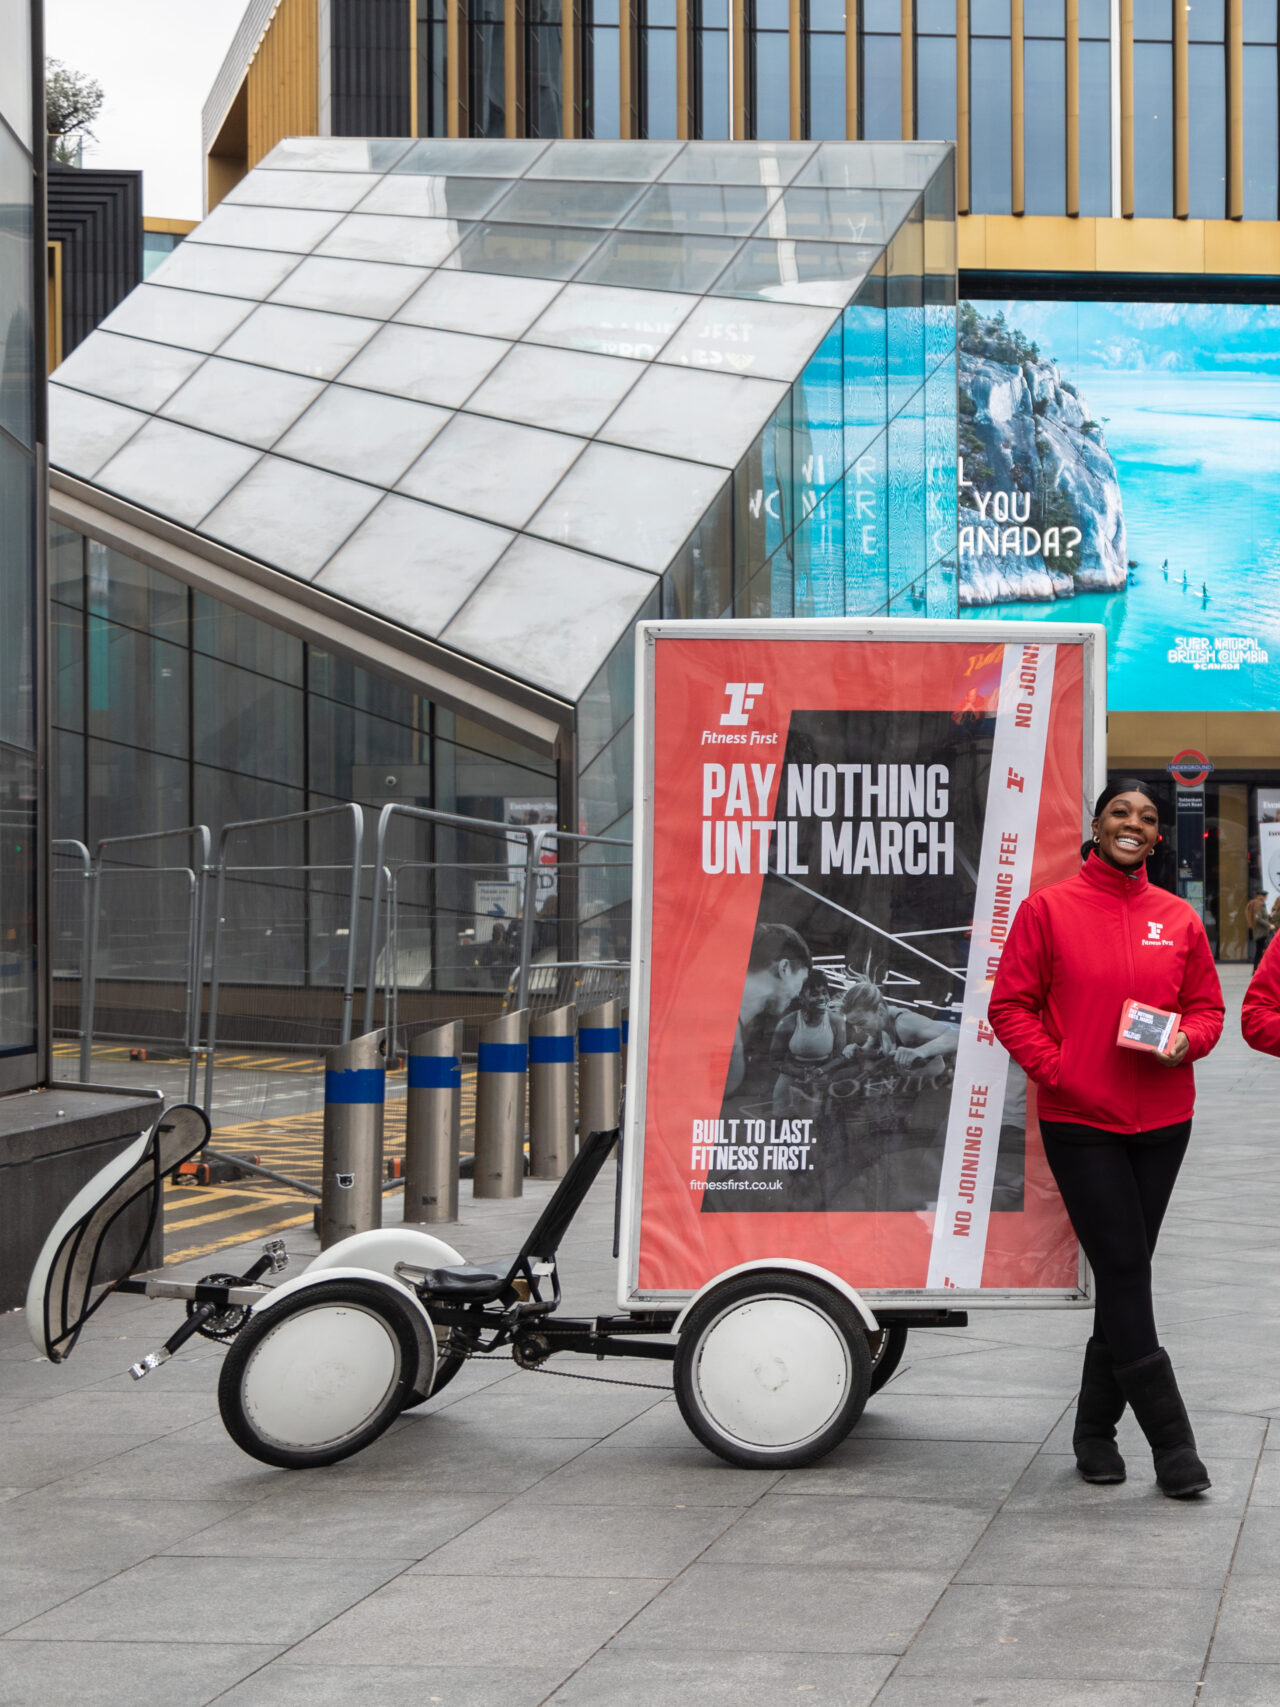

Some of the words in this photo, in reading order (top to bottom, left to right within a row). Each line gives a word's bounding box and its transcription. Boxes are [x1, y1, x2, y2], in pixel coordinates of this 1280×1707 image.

[976, 491, 1031, 522] YOU
[1019, 643, 1040, 696] JOINI
[1015, 702, 1033, 728] NO
[703, 763, 776, 816] PAY
[787, 763, 949, 818] NOTHING
[702, 821, 809, 874] UNTIL
[821, 821, 954, 875] MARCH
[998, 832, 1018, 866] FEE
[969, 1084, 989, 1119] FEE
[693, 1119, 740, 1144] BUILT
[744, 1119, 766, 1144] TO
[770, 1119, 817, 1144] LAST.
[691, 1146, 758, 1170] FITNESS
[763, 1146, 814, 1170] FIRST.
[958, 1125, 984, 1204] JOINING
[689, 1179, 783, 1191] fitnessfirst.co.uk
[953, 1210, 972, 1237] NO
